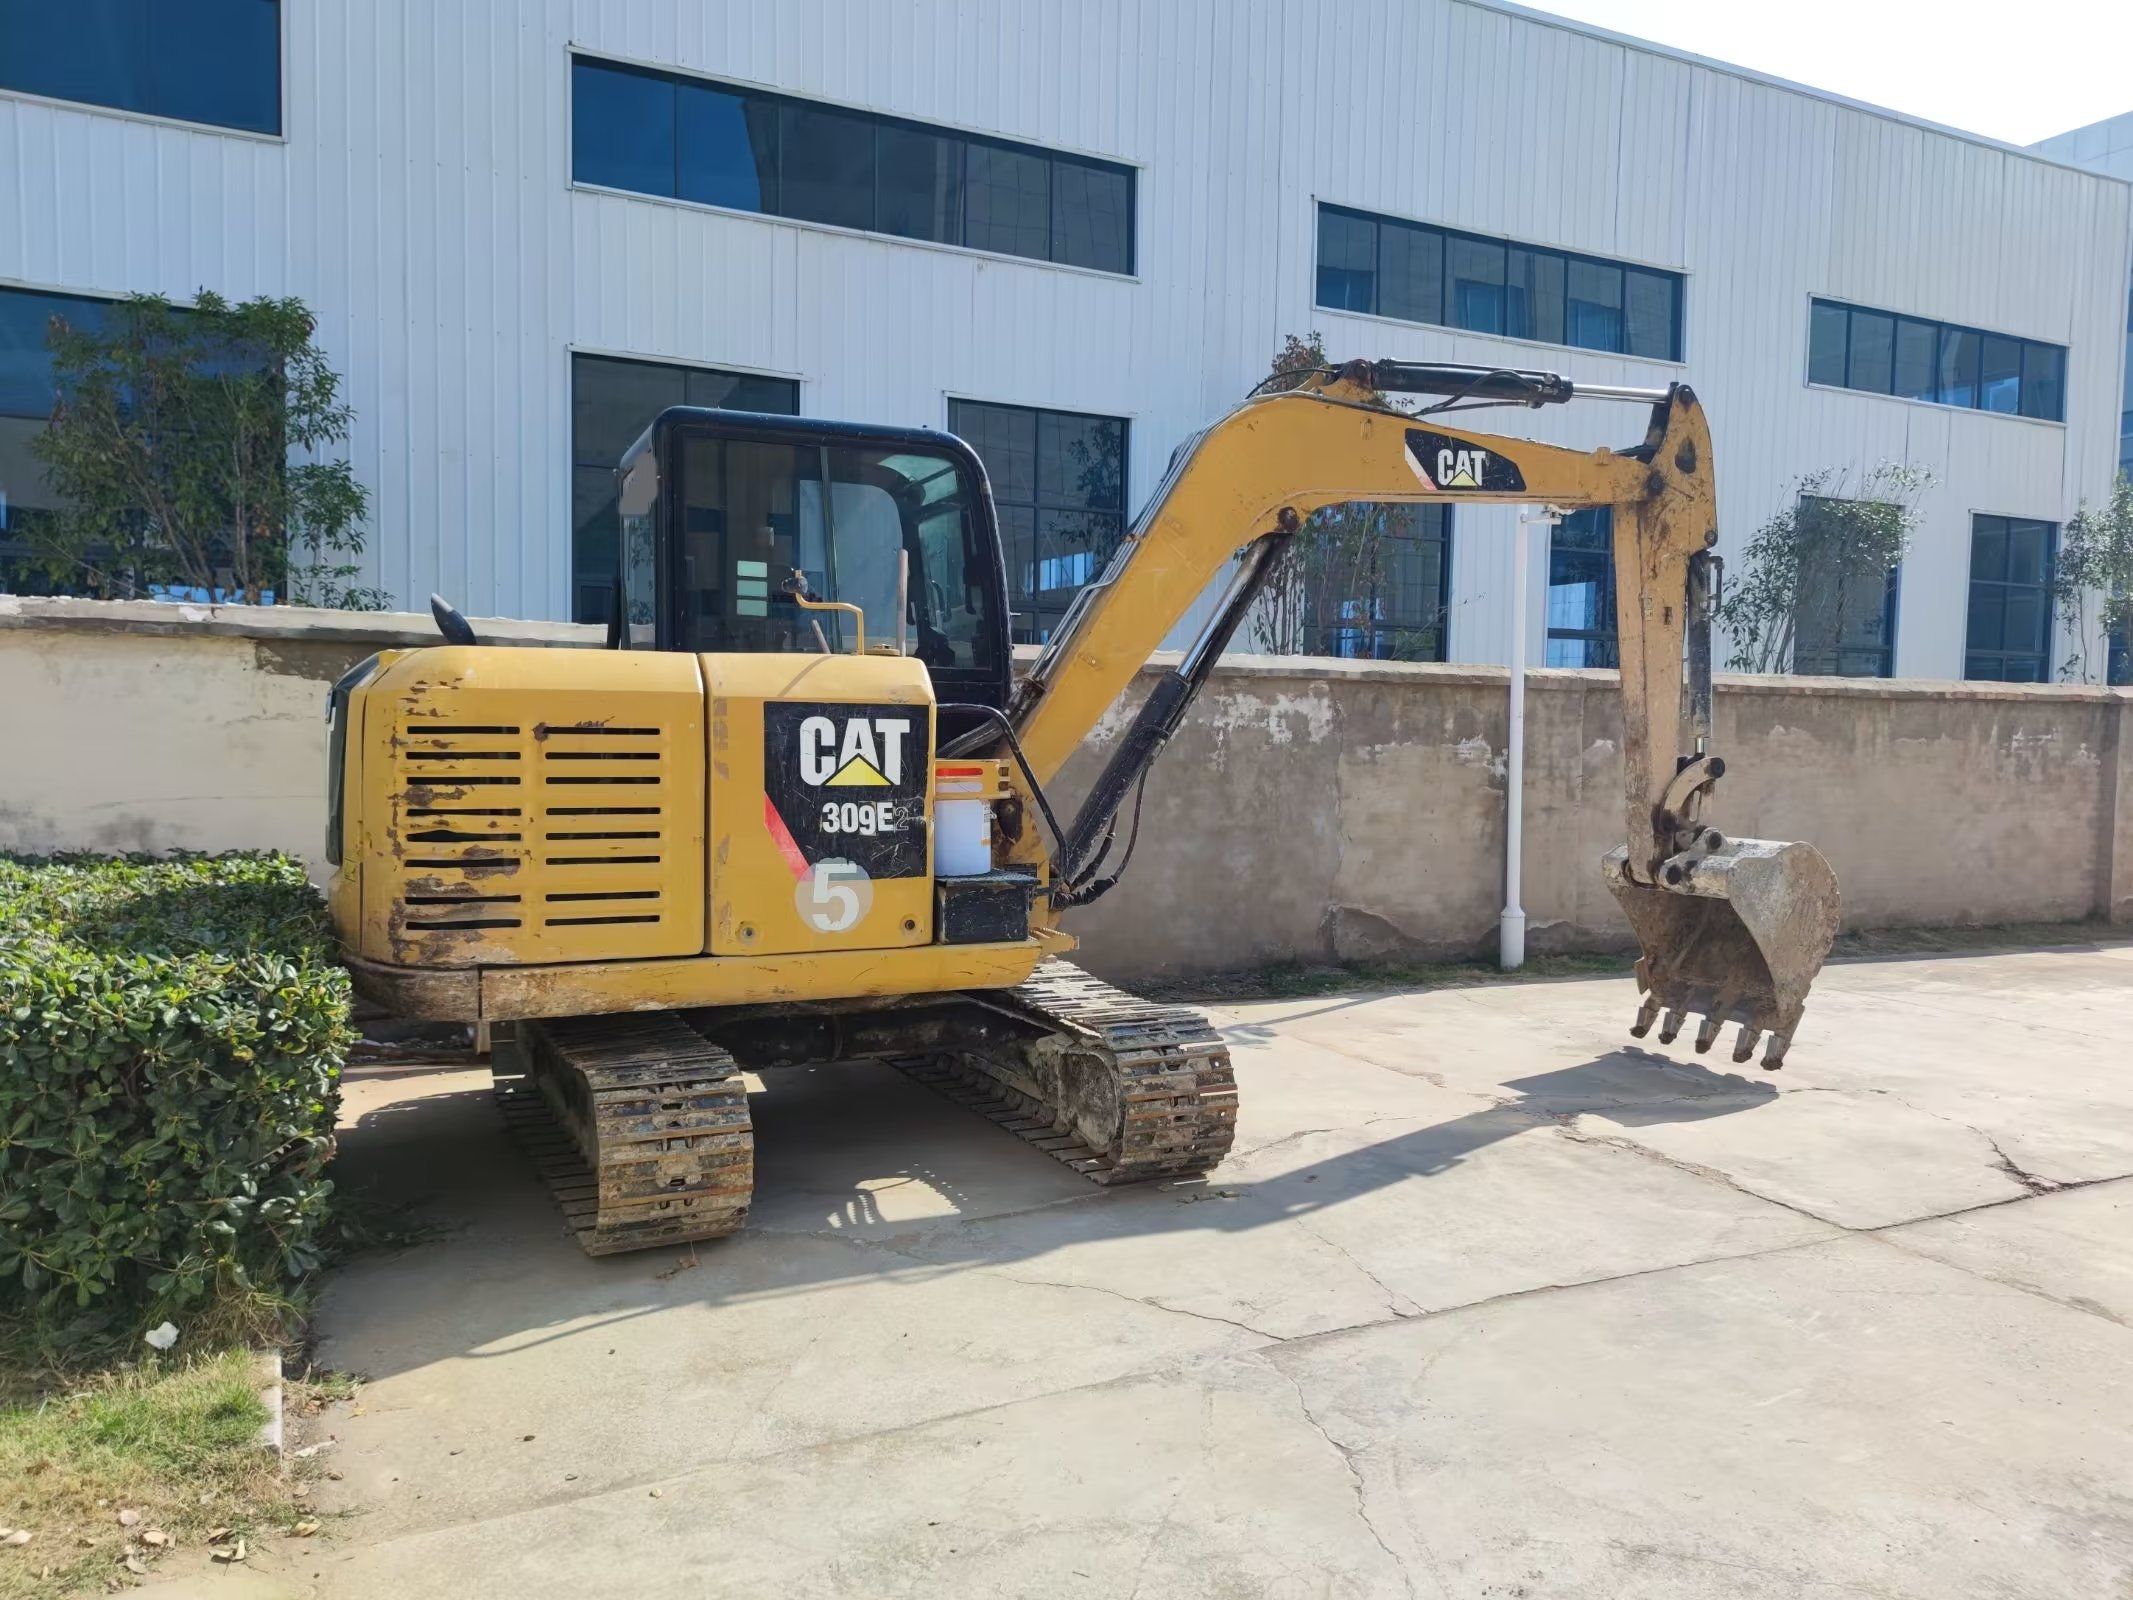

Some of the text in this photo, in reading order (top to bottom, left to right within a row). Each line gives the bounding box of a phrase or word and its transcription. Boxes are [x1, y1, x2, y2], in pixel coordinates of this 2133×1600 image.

[1437, 449, 1486, 486] CAT
[800, 716, 910, 786] CAT
[812, 860, 860, 931] 5
